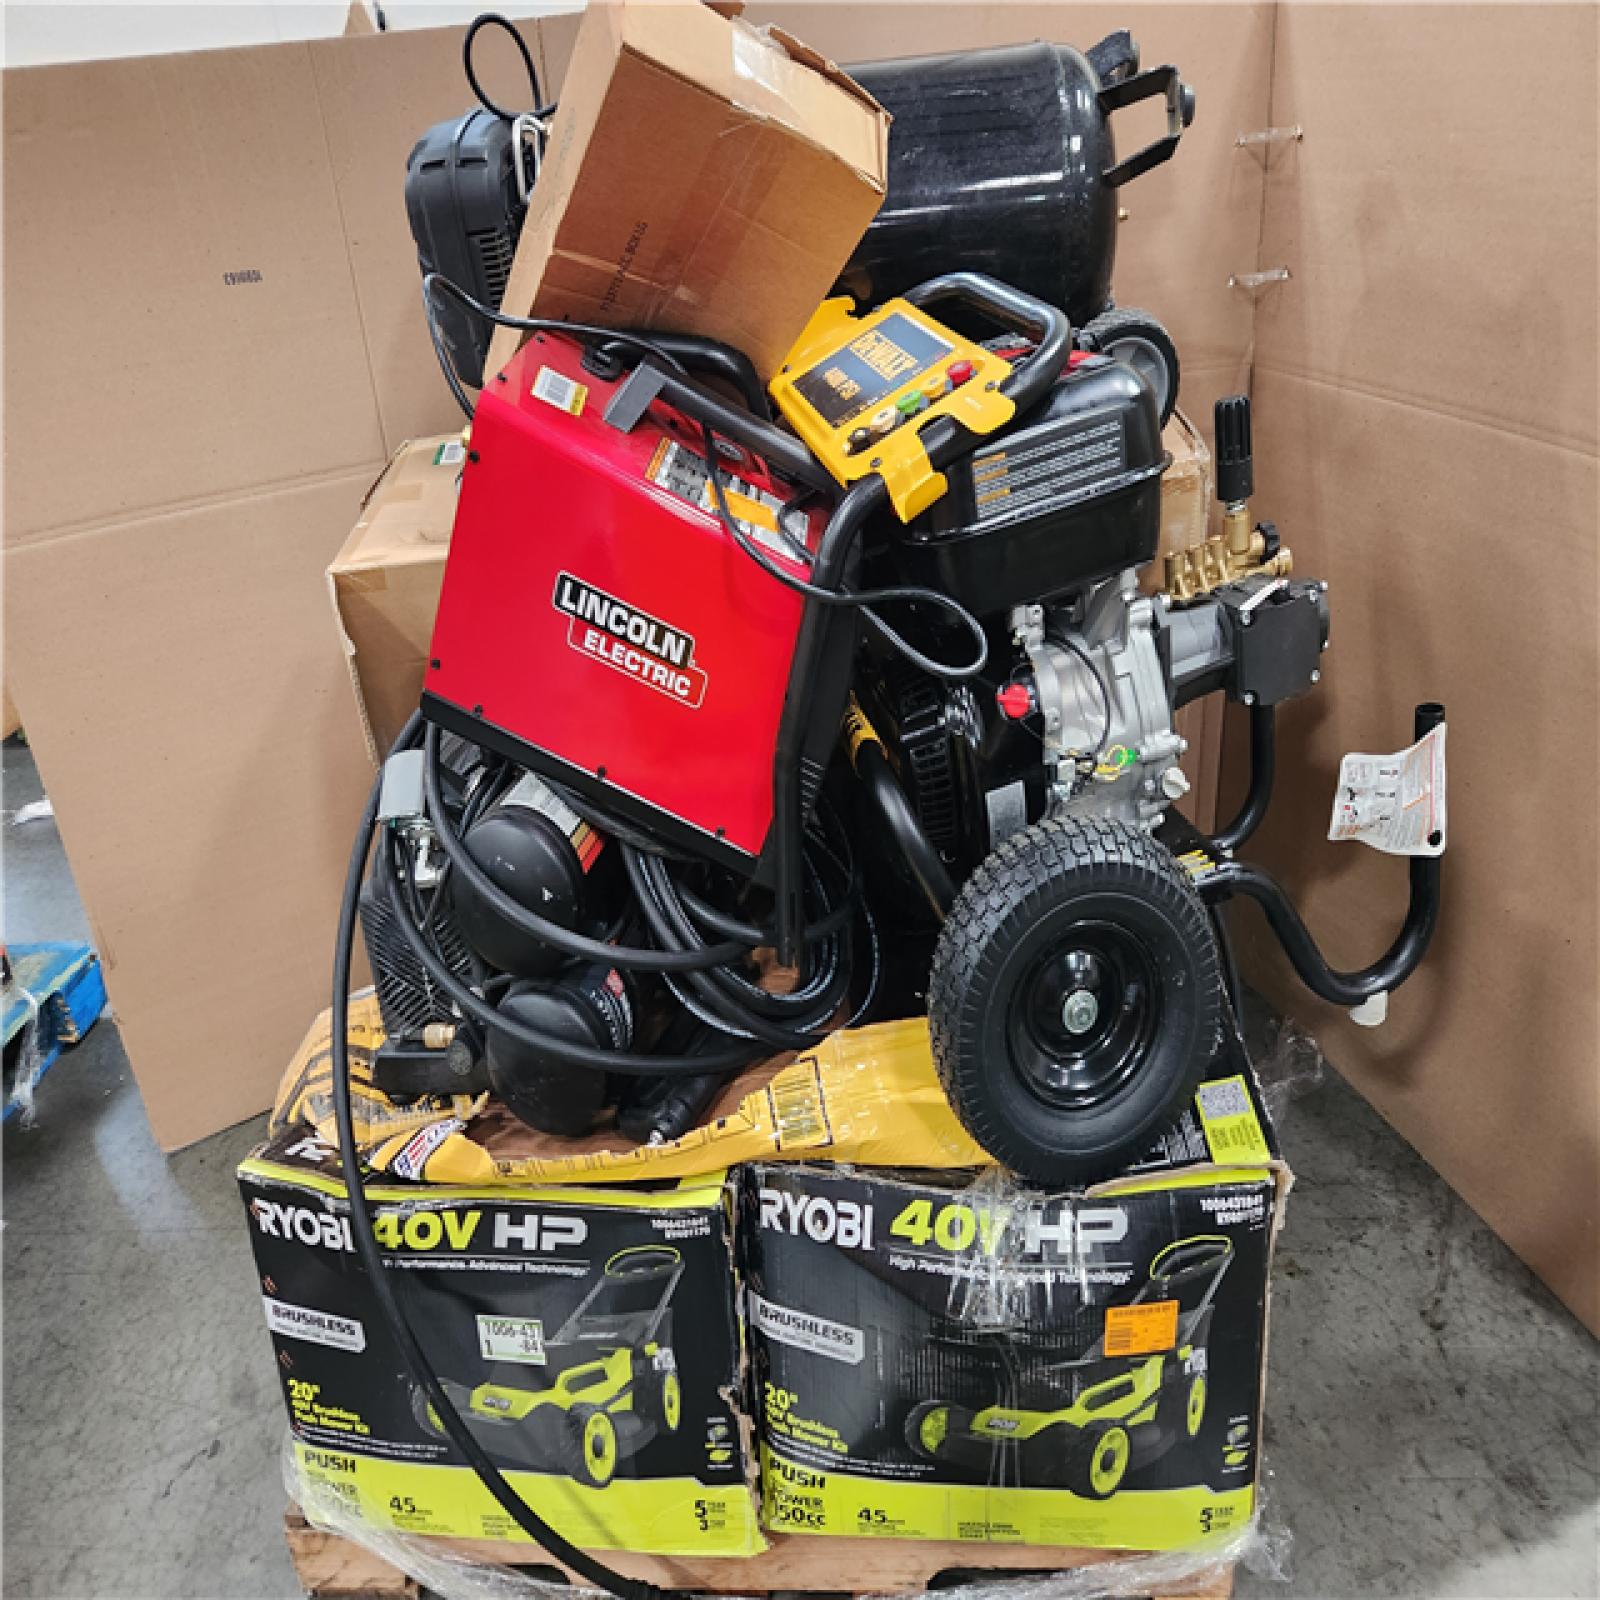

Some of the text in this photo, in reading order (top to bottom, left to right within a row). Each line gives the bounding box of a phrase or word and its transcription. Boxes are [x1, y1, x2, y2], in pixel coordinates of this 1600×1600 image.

[560, 580, 686, 666] LINCOLN
[583, 629, 691, 697] ELECTRIC
[254, 1198, 355, 1252] RYOBI
[375, 1210, 588, 1250] 40V HP
[760, 1189, 875, 1250] RYOBI
[1025, 1207, 1128, 1253] HP
[889, 1254, 916, 1270] High
[272, 1304, 356, 1336] BRUSHLESS
[759, 1303, 856, 1346] BRUSHLESS
[305, 1450, 356, 1473] PUSH
[770, 1456, 826, 1488] PUSH
[390, 1496, 415, 1513] 45
[695, 1500, 707, 1518] 5
[857, 1506, 887, 1523] 45
